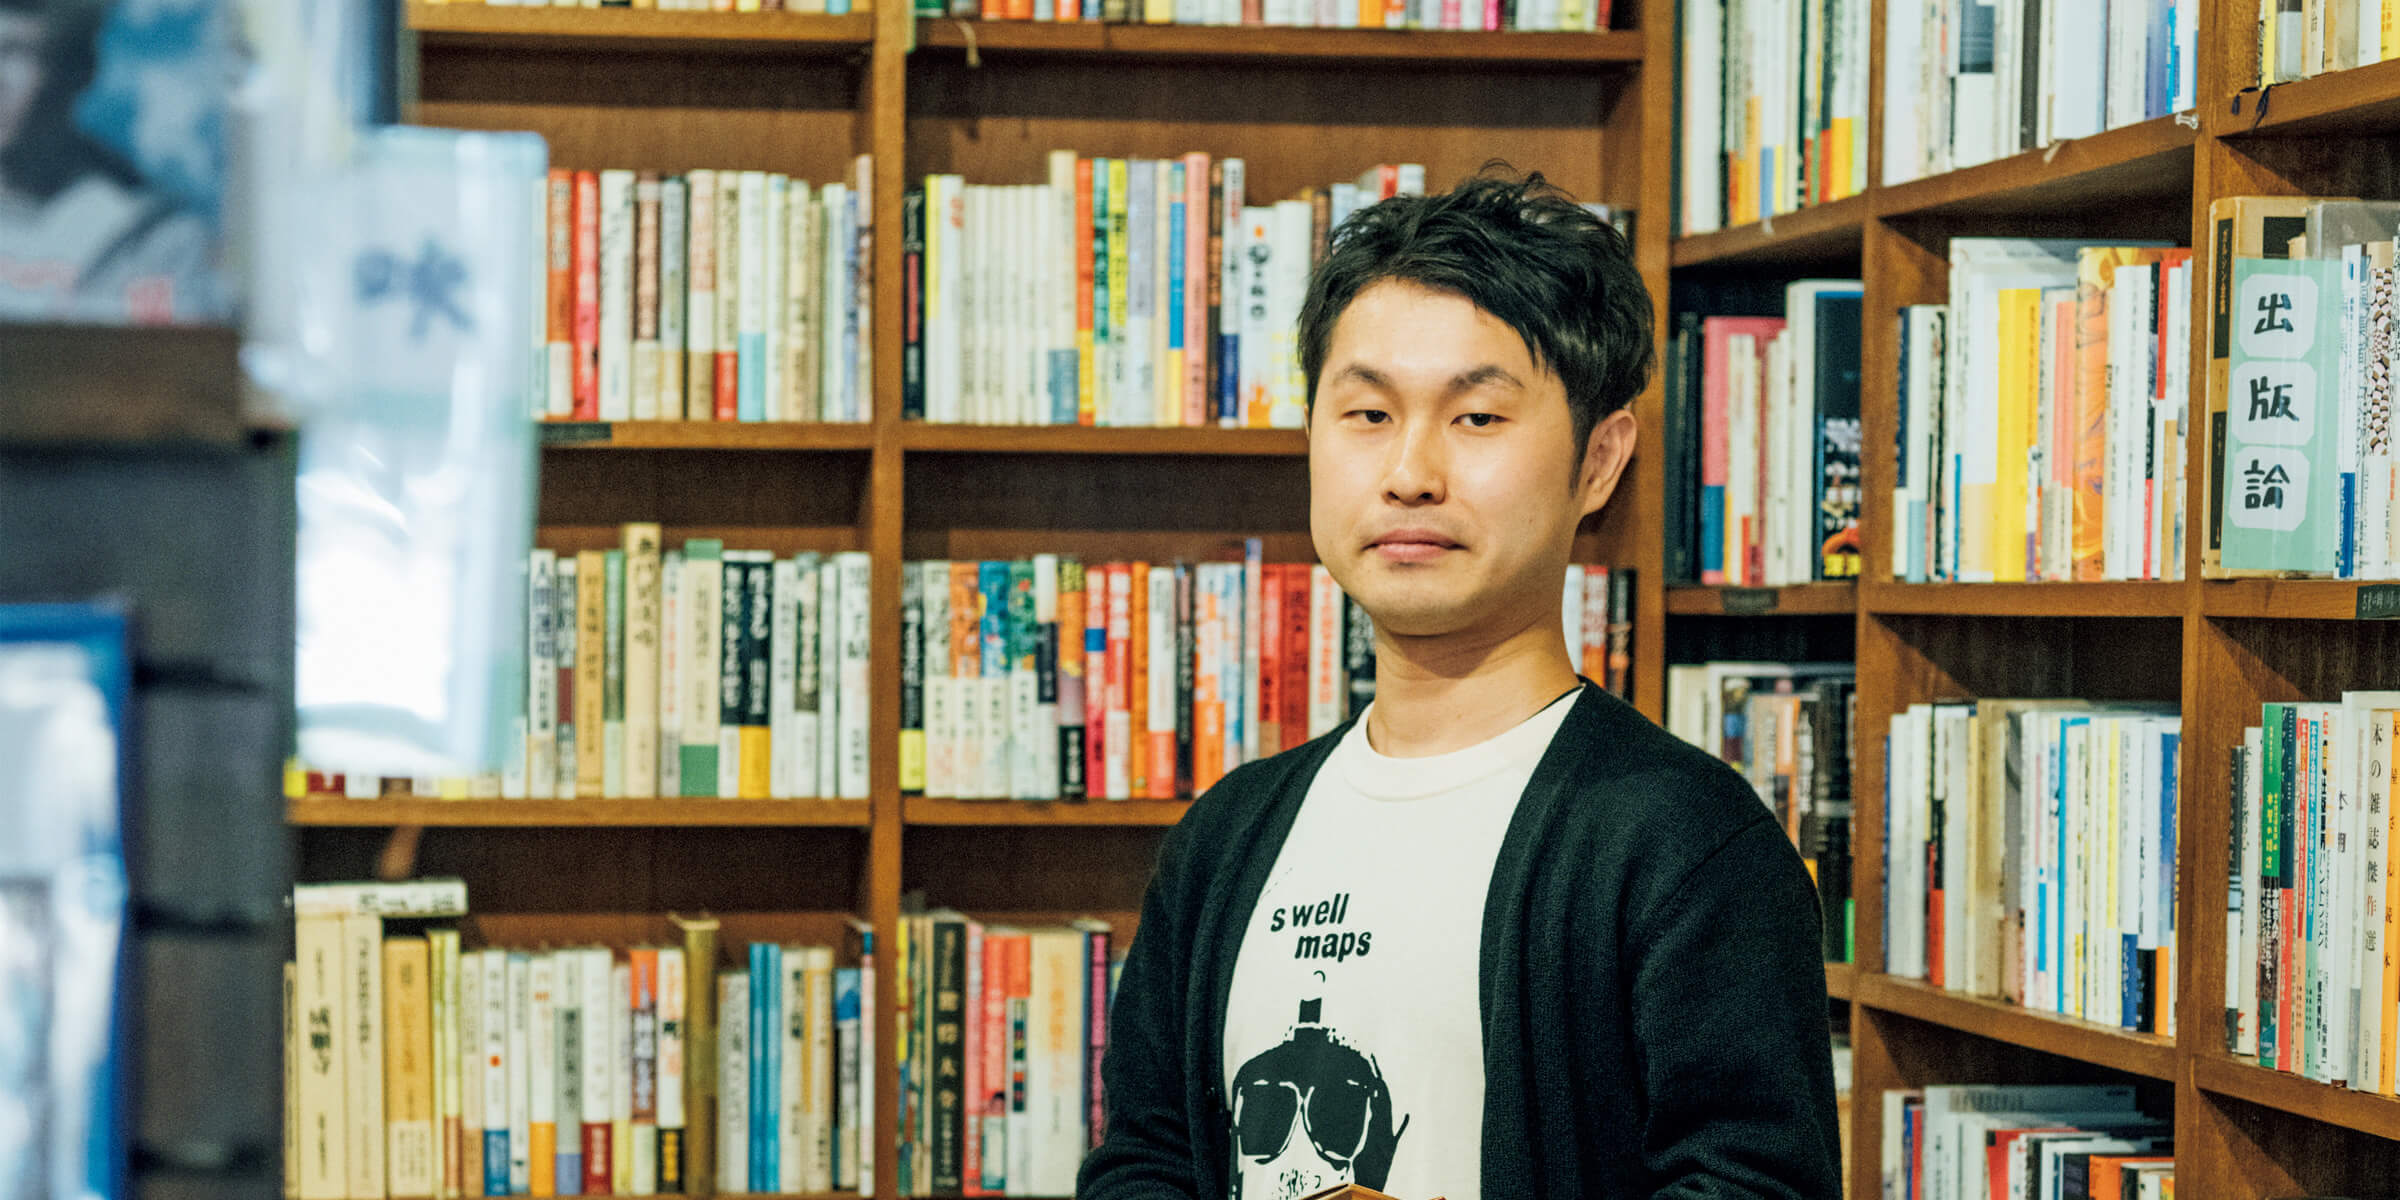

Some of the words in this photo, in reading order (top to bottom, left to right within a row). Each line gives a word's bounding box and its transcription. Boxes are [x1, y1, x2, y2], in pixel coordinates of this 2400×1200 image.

[2242, 292, 2299, 510] 出版論
[2365, 722, 2383, 952] 本の雑誌傑作選
[1294, 931, 1372, 963] maps
